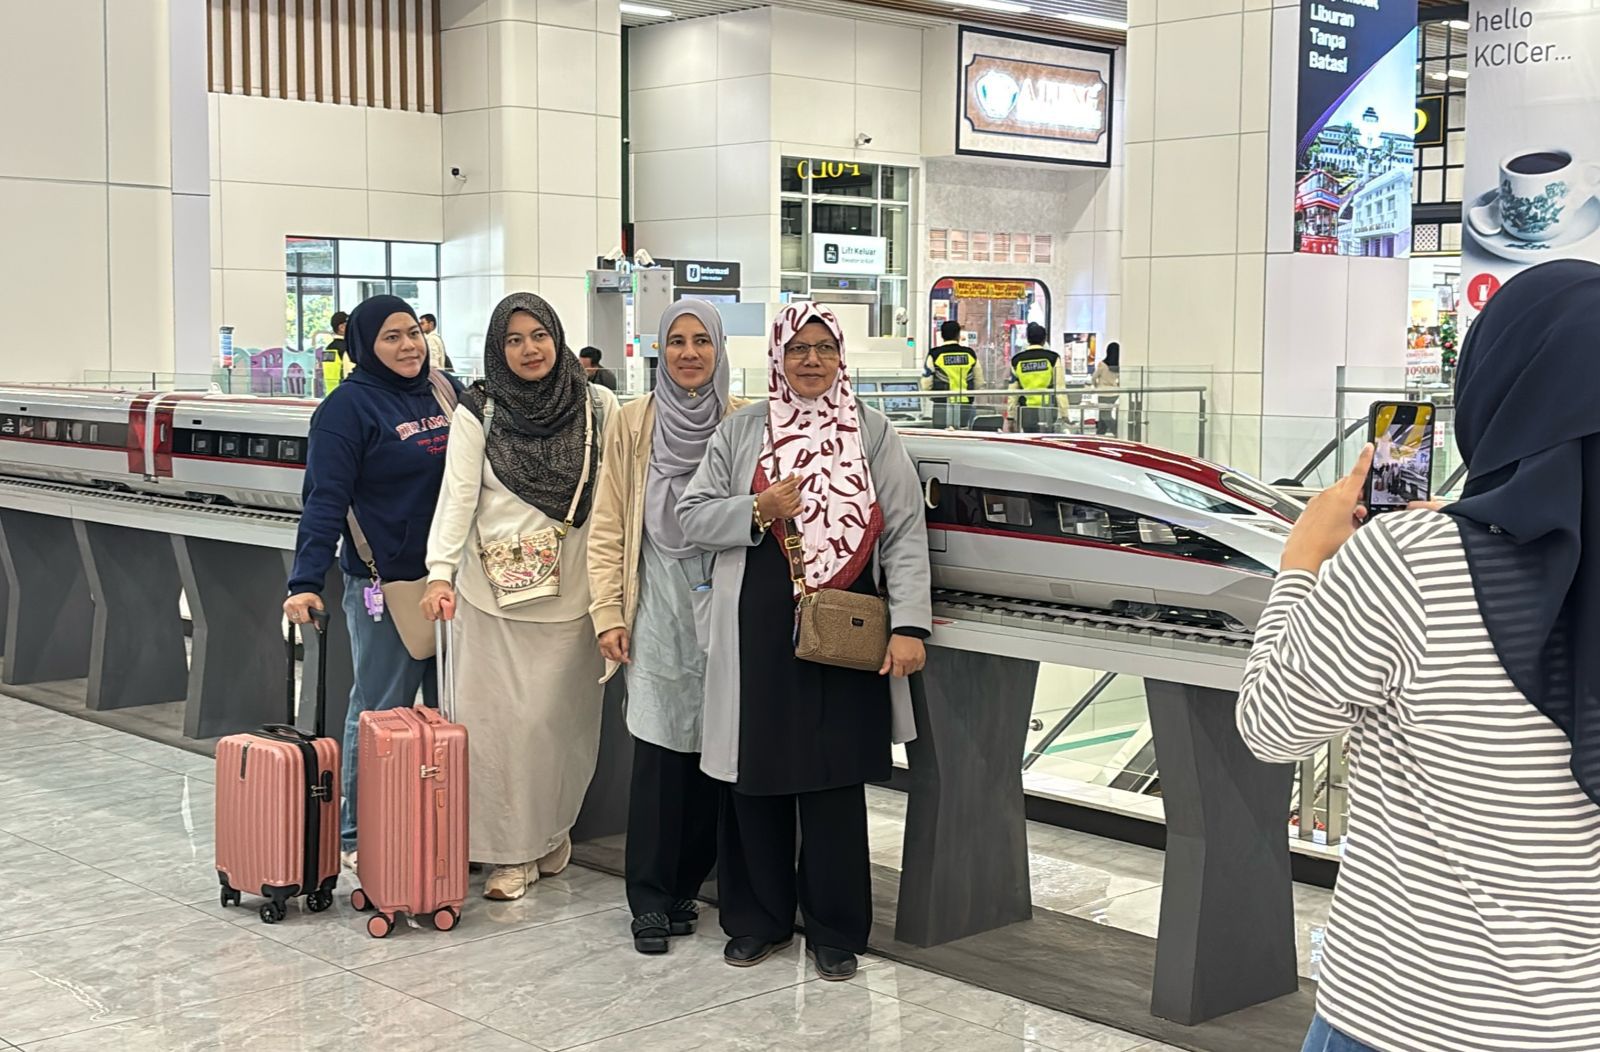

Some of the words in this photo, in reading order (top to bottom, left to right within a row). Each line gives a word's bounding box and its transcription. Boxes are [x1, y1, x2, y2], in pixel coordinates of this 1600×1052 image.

[1310, 3, 1355, 28] Liburan
[1475, 7, 1533, 32] hello
[1309, 27, 1347, 51] Tanpa
[1474, 41, 1572, 68] KCICer...
[841, 246, 854, 255] Lift
[855, 247, 876, 256] Keluar
[945, 355, 968, 365] SECURITY
